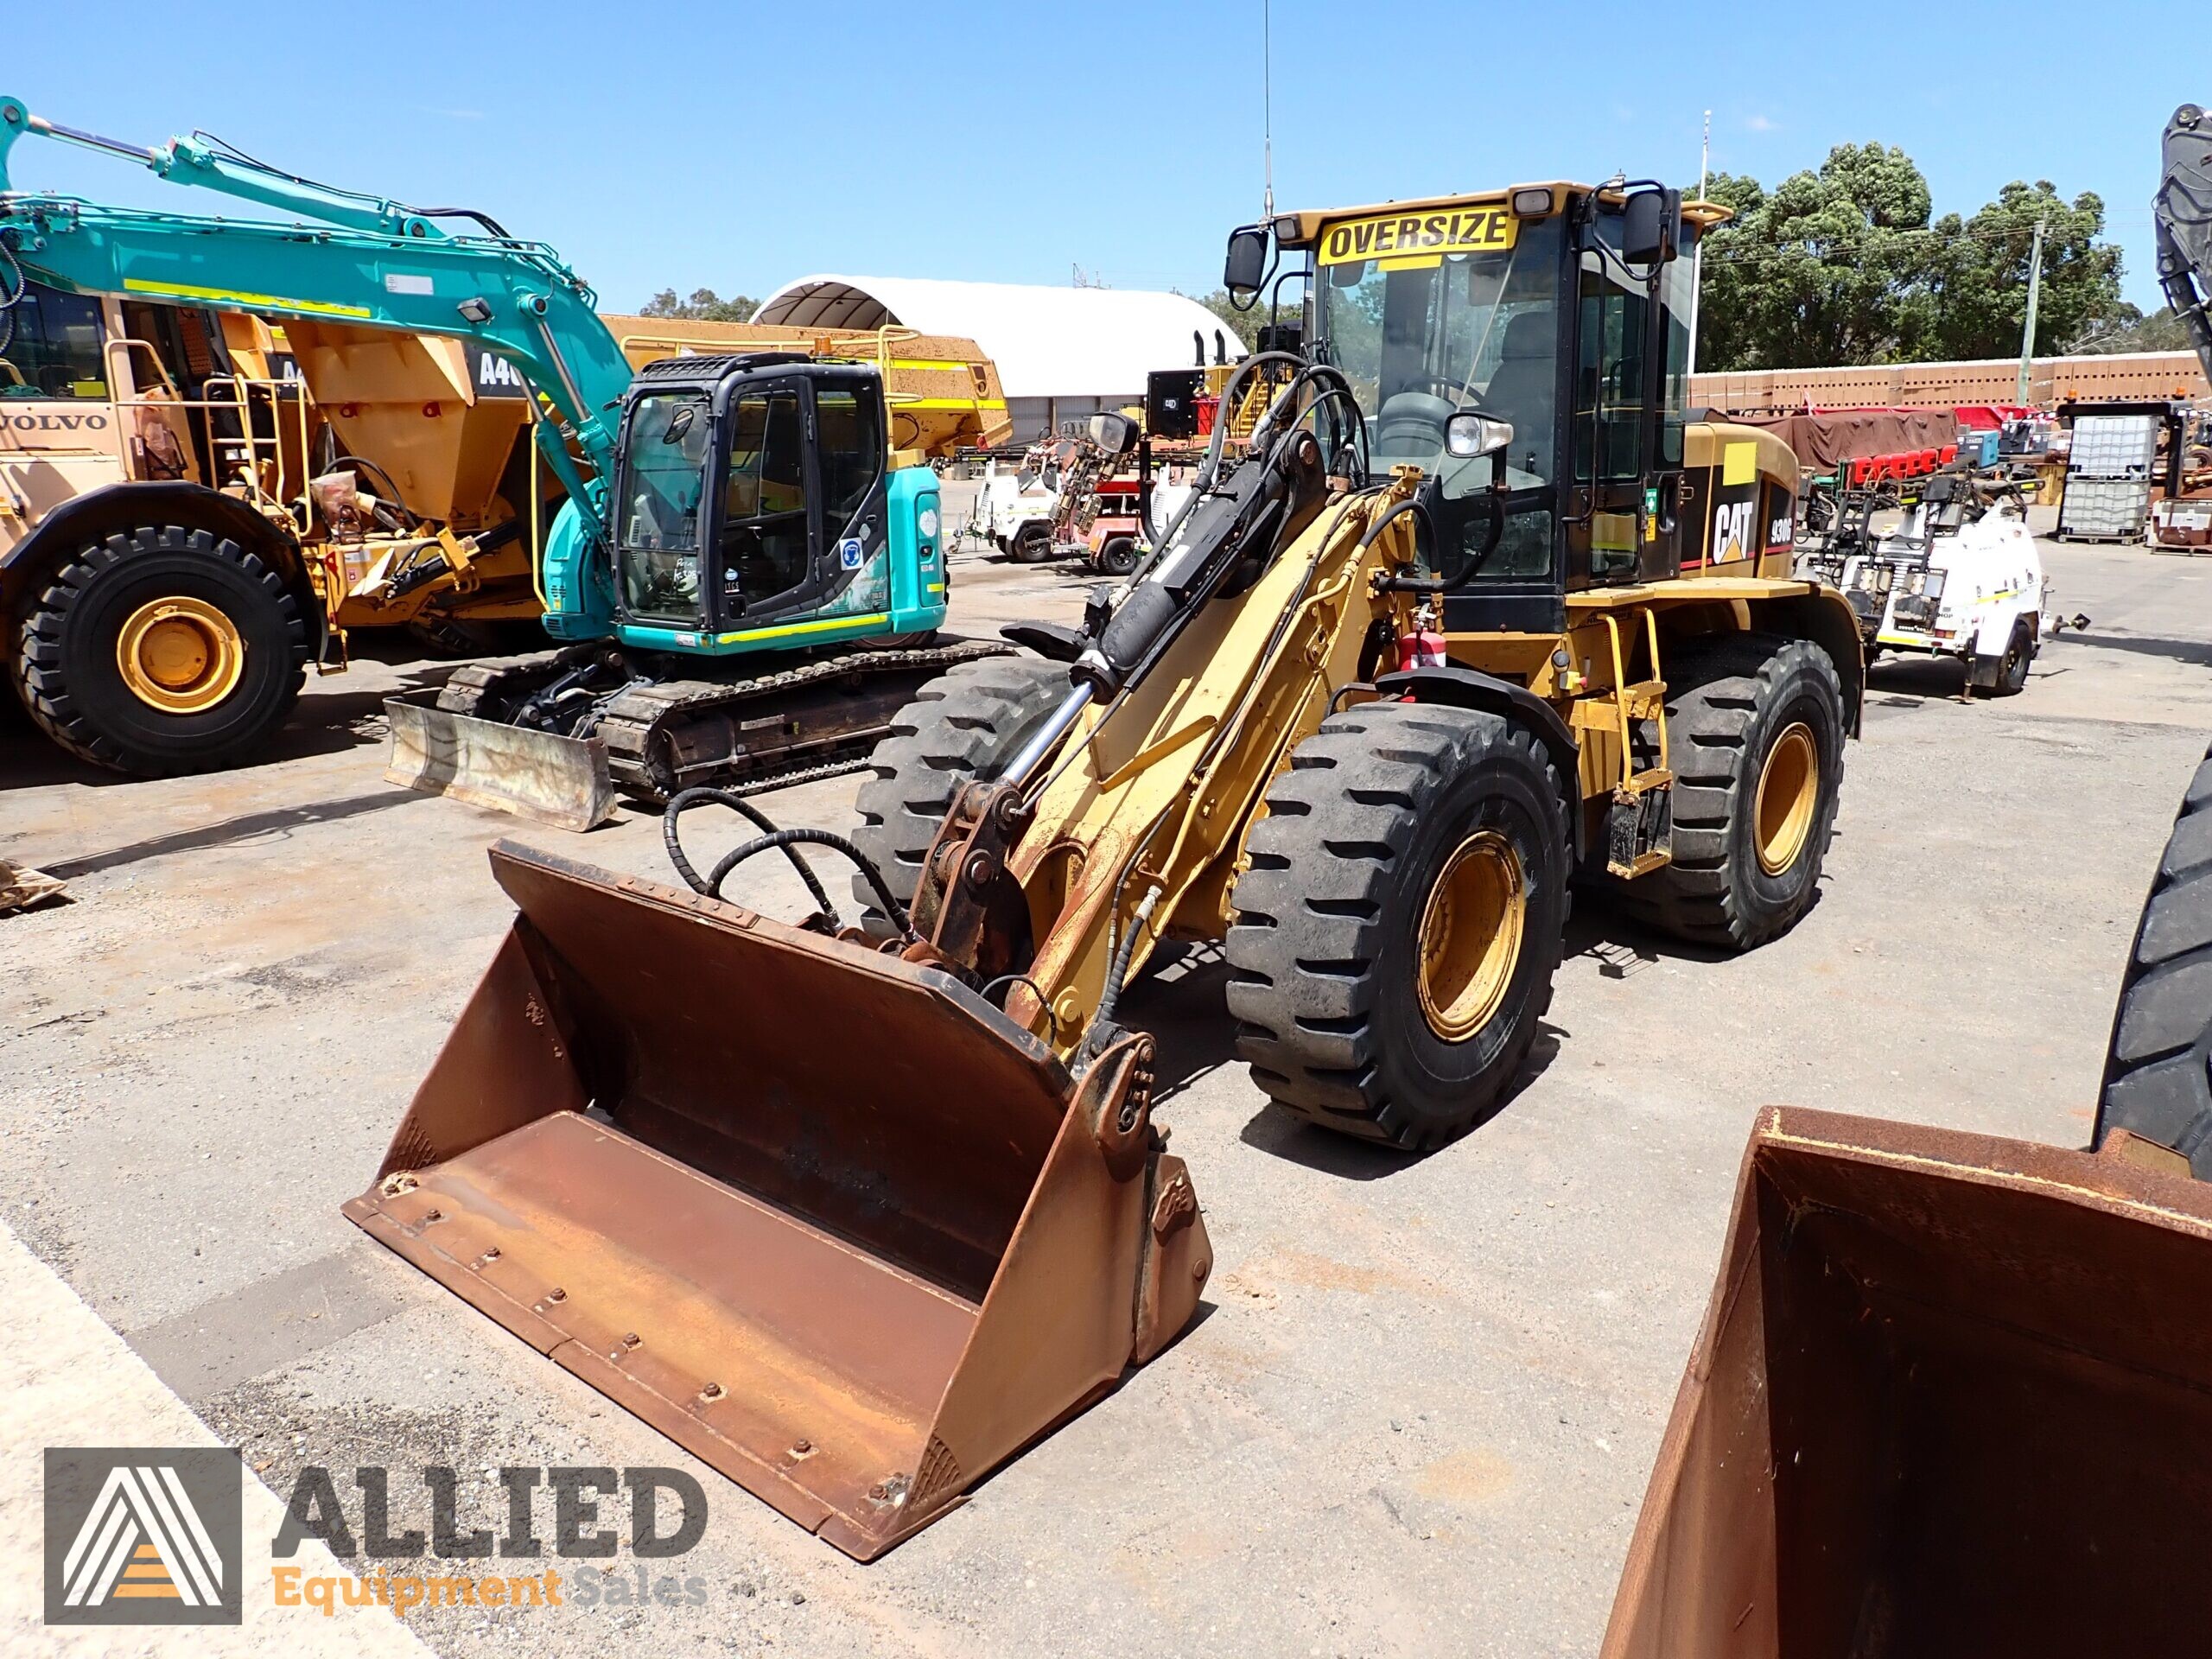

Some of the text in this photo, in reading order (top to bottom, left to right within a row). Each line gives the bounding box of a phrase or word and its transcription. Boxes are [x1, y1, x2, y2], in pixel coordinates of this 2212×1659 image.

[1329, 211, 1509, 258] OVERSIZE
[1713, 501, 1752, 565] CAT
[1771, 518, 1793, 544] 930G
